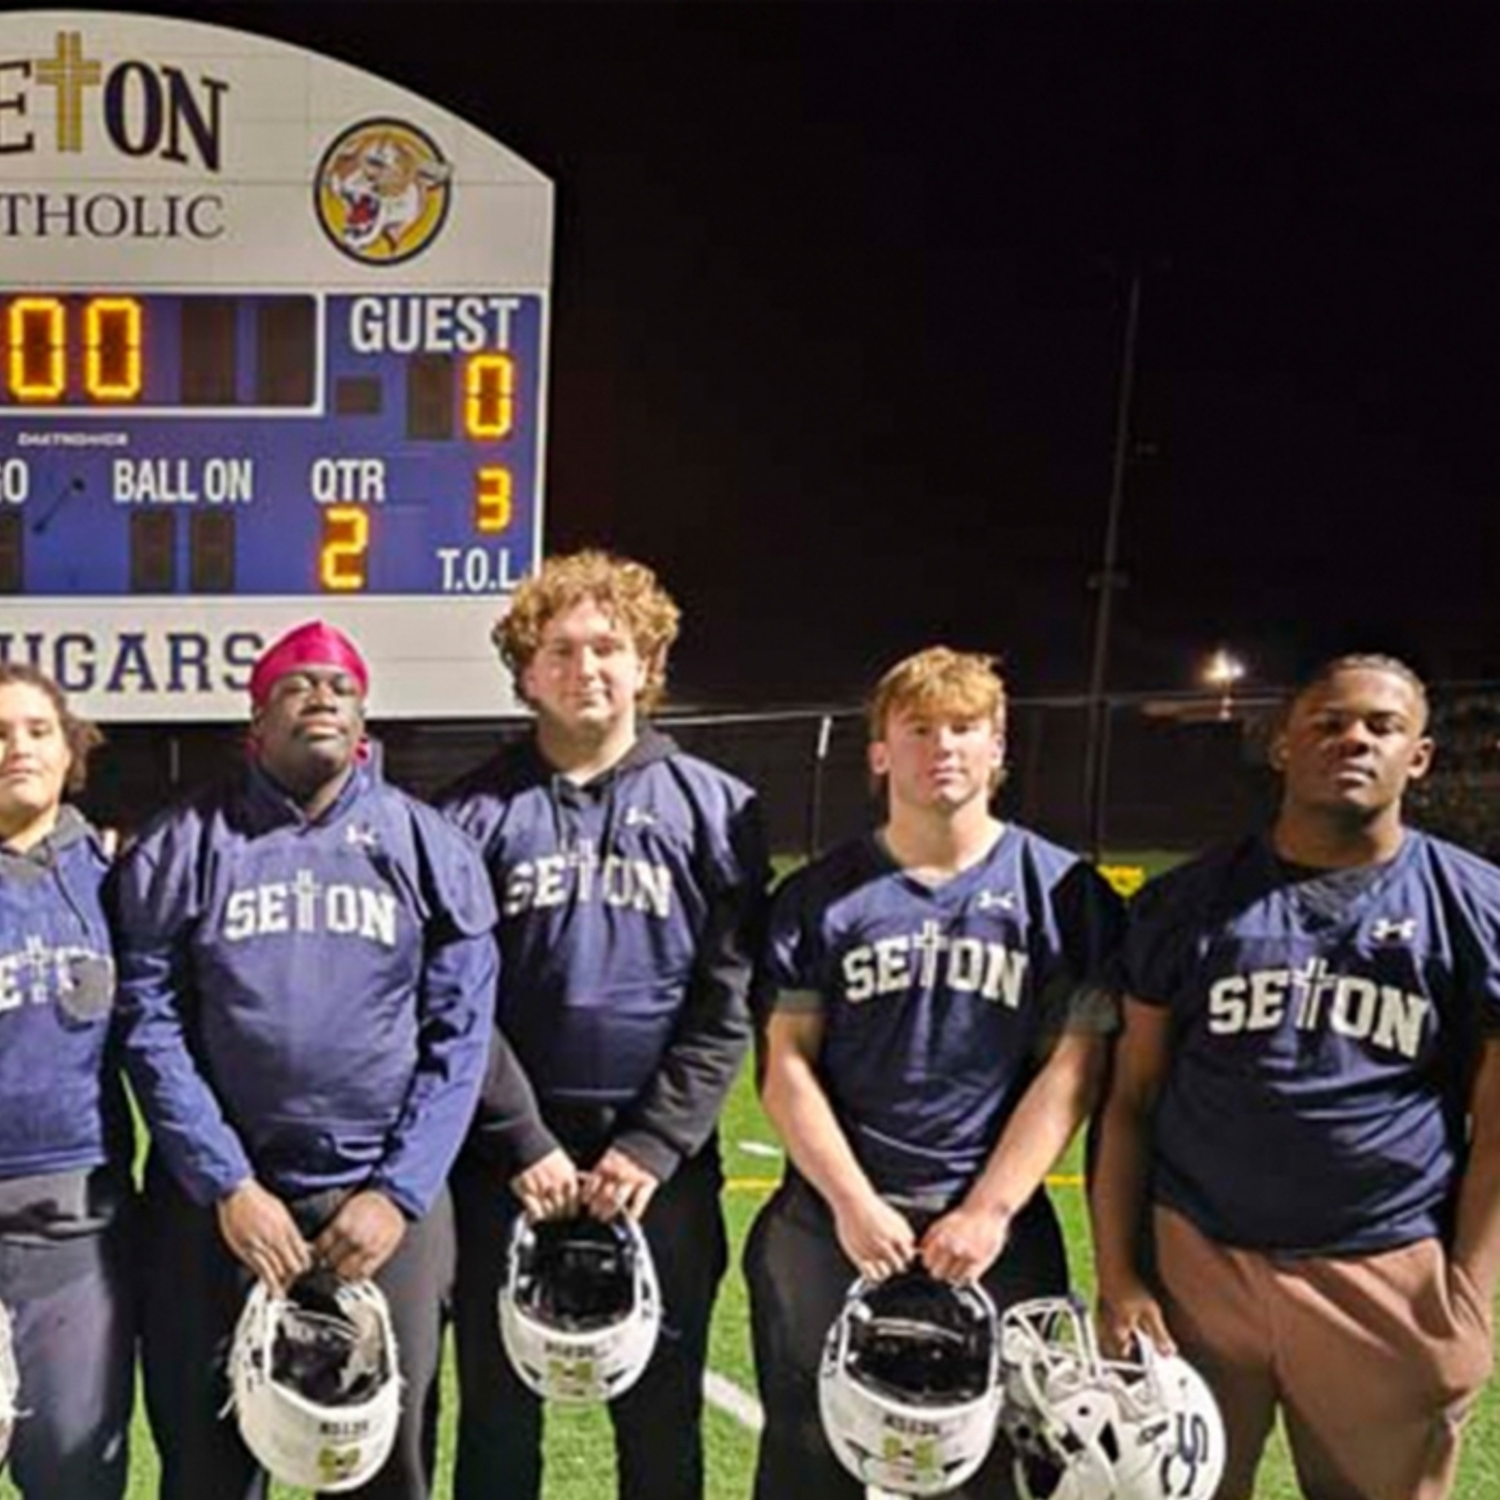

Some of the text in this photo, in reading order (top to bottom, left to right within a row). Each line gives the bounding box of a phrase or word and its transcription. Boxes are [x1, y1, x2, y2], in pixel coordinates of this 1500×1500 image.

[350, 297, 520, 353] GUEST
[465, 353, 514, 438] 0
[113, 458, 253, 502] BALL ON
[311, 458, 385, 502] QTR
[478, 467, 512, 532] 3
[321, 506, 368, 591] 2
[225, 870, 397, 948] SETON
[503, 838, 673, 918] SETON
[840, 920, 1026, 1008] SETON
[1207, 957, 1431, 1060] SETON
